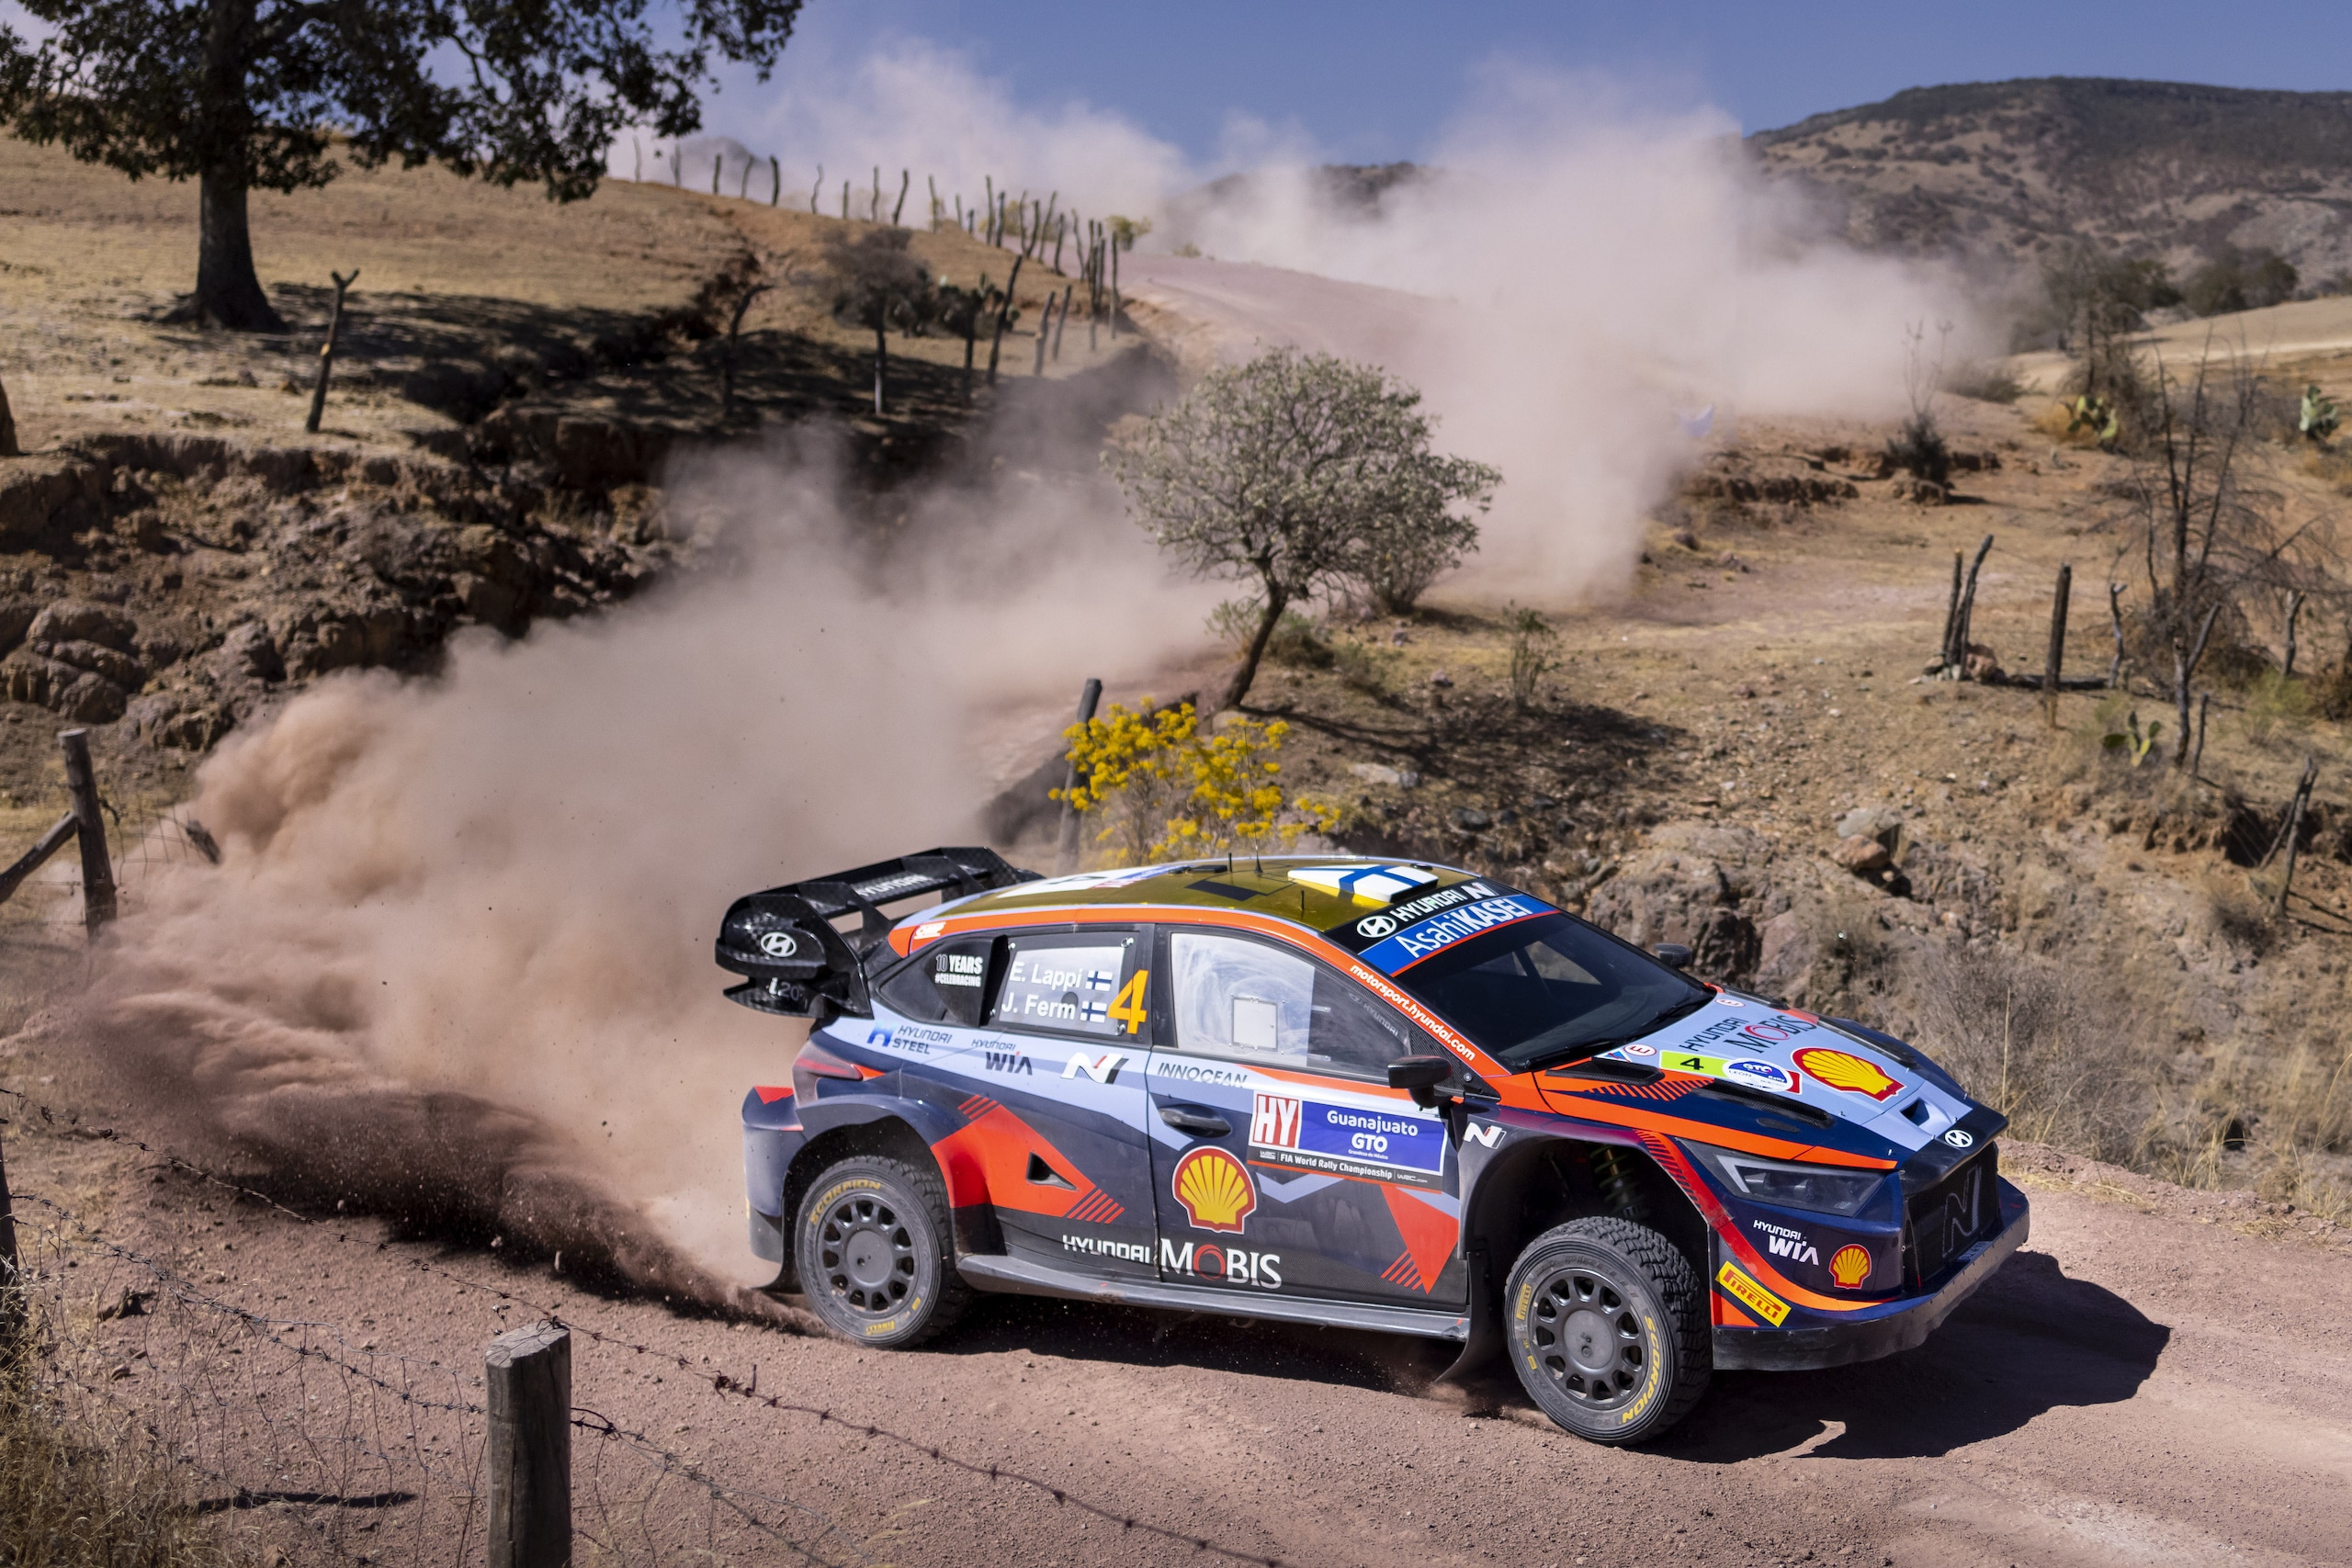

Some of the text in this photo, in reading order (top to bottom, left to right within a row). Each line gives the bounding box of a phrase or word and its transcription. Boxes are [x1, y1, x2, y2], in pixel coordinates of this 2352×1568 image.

[1390, 888, 1468, 921] HYUNDAI
[1395, 898, 1533, 958] AsahiKASEI
[935, 953, 983, 975] 10 YEARS
[1010, 961, 1082, 991] E. Lappi
[1001, 992, 1076, 1021] J. Ferm
[1107, 969, 1149, 1034] 4
[1350, 964, 1476, 1061] motorsport.hyundai.com
[898, 1024, 953, 1044] HYUNDAI
[1363, 1003, 1398, 1037] HYUNDAI
[1679, 1017, 1749, 1052] HYUNDAI
[1723, 1015, 1817, 1054] MOBIS
[891, 1037, 931, 1055] STEEL
[971, 1038, 1016, 1052] HYUNDAI
[1158, 1062, 1248, 1088] INNOCEAN
[1679, 1057, 1704, 1070] 4
[1253, 1095, 1298, 1146] HY
[1327, 1110, 1419, 1137] Guanajuato
[1351, 1133, 1388, 1153] GTO
[1280, 1153, 1393, 1180] FIA World Rally Championship
[810, 1179, 882, 1225] SCORPION
[1753, 1219, 1802, 1240] HYUNDAI
[1062, 1235, 1150, 1264] HYUNDAI
[1160, 1238, 1283, 1289] MOBIS
[1723, 1269, 1782, 1319] PIRELLI
[1622, 1314, 1662, 1424] SCORPION
